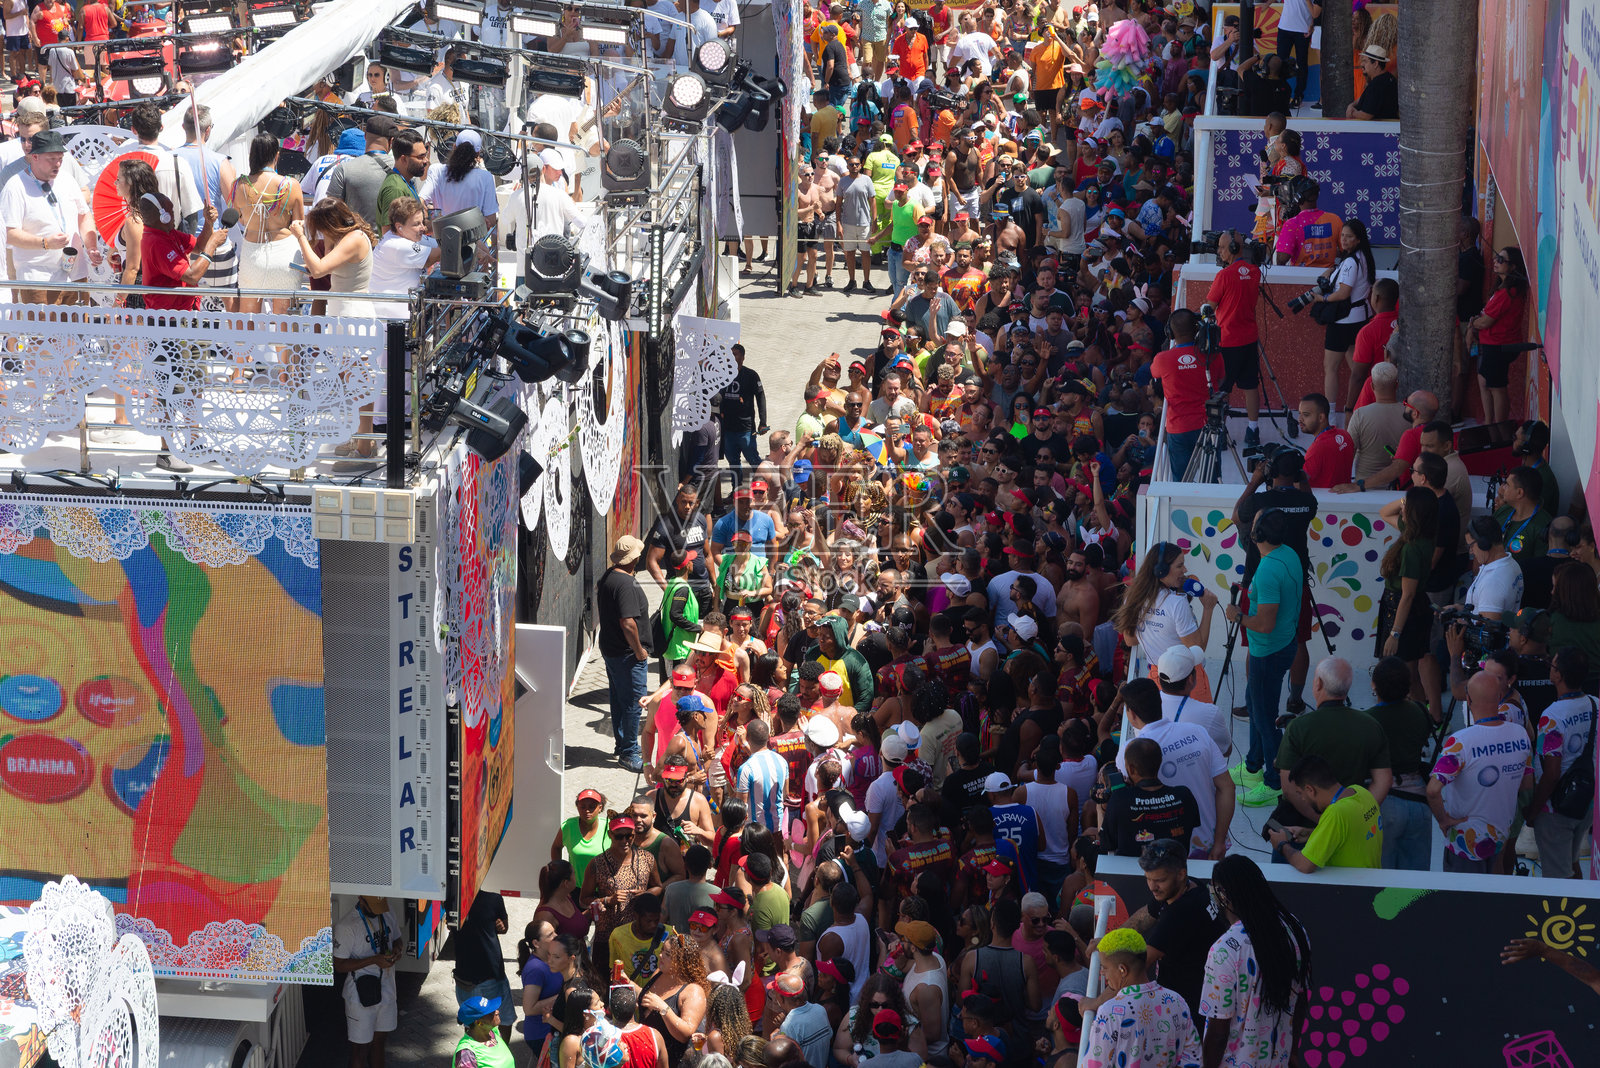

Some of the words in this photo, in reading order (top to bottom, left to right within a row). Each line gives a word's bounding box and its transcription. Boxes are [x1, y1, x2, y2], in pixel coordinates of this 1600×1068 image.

[1161, 734, 1199, 757] PRENSA
[7, 757, 76, 776] BRAHMA
[862, 755, 876, 777] 20
[1135, 794, 1175, 806] Produção
